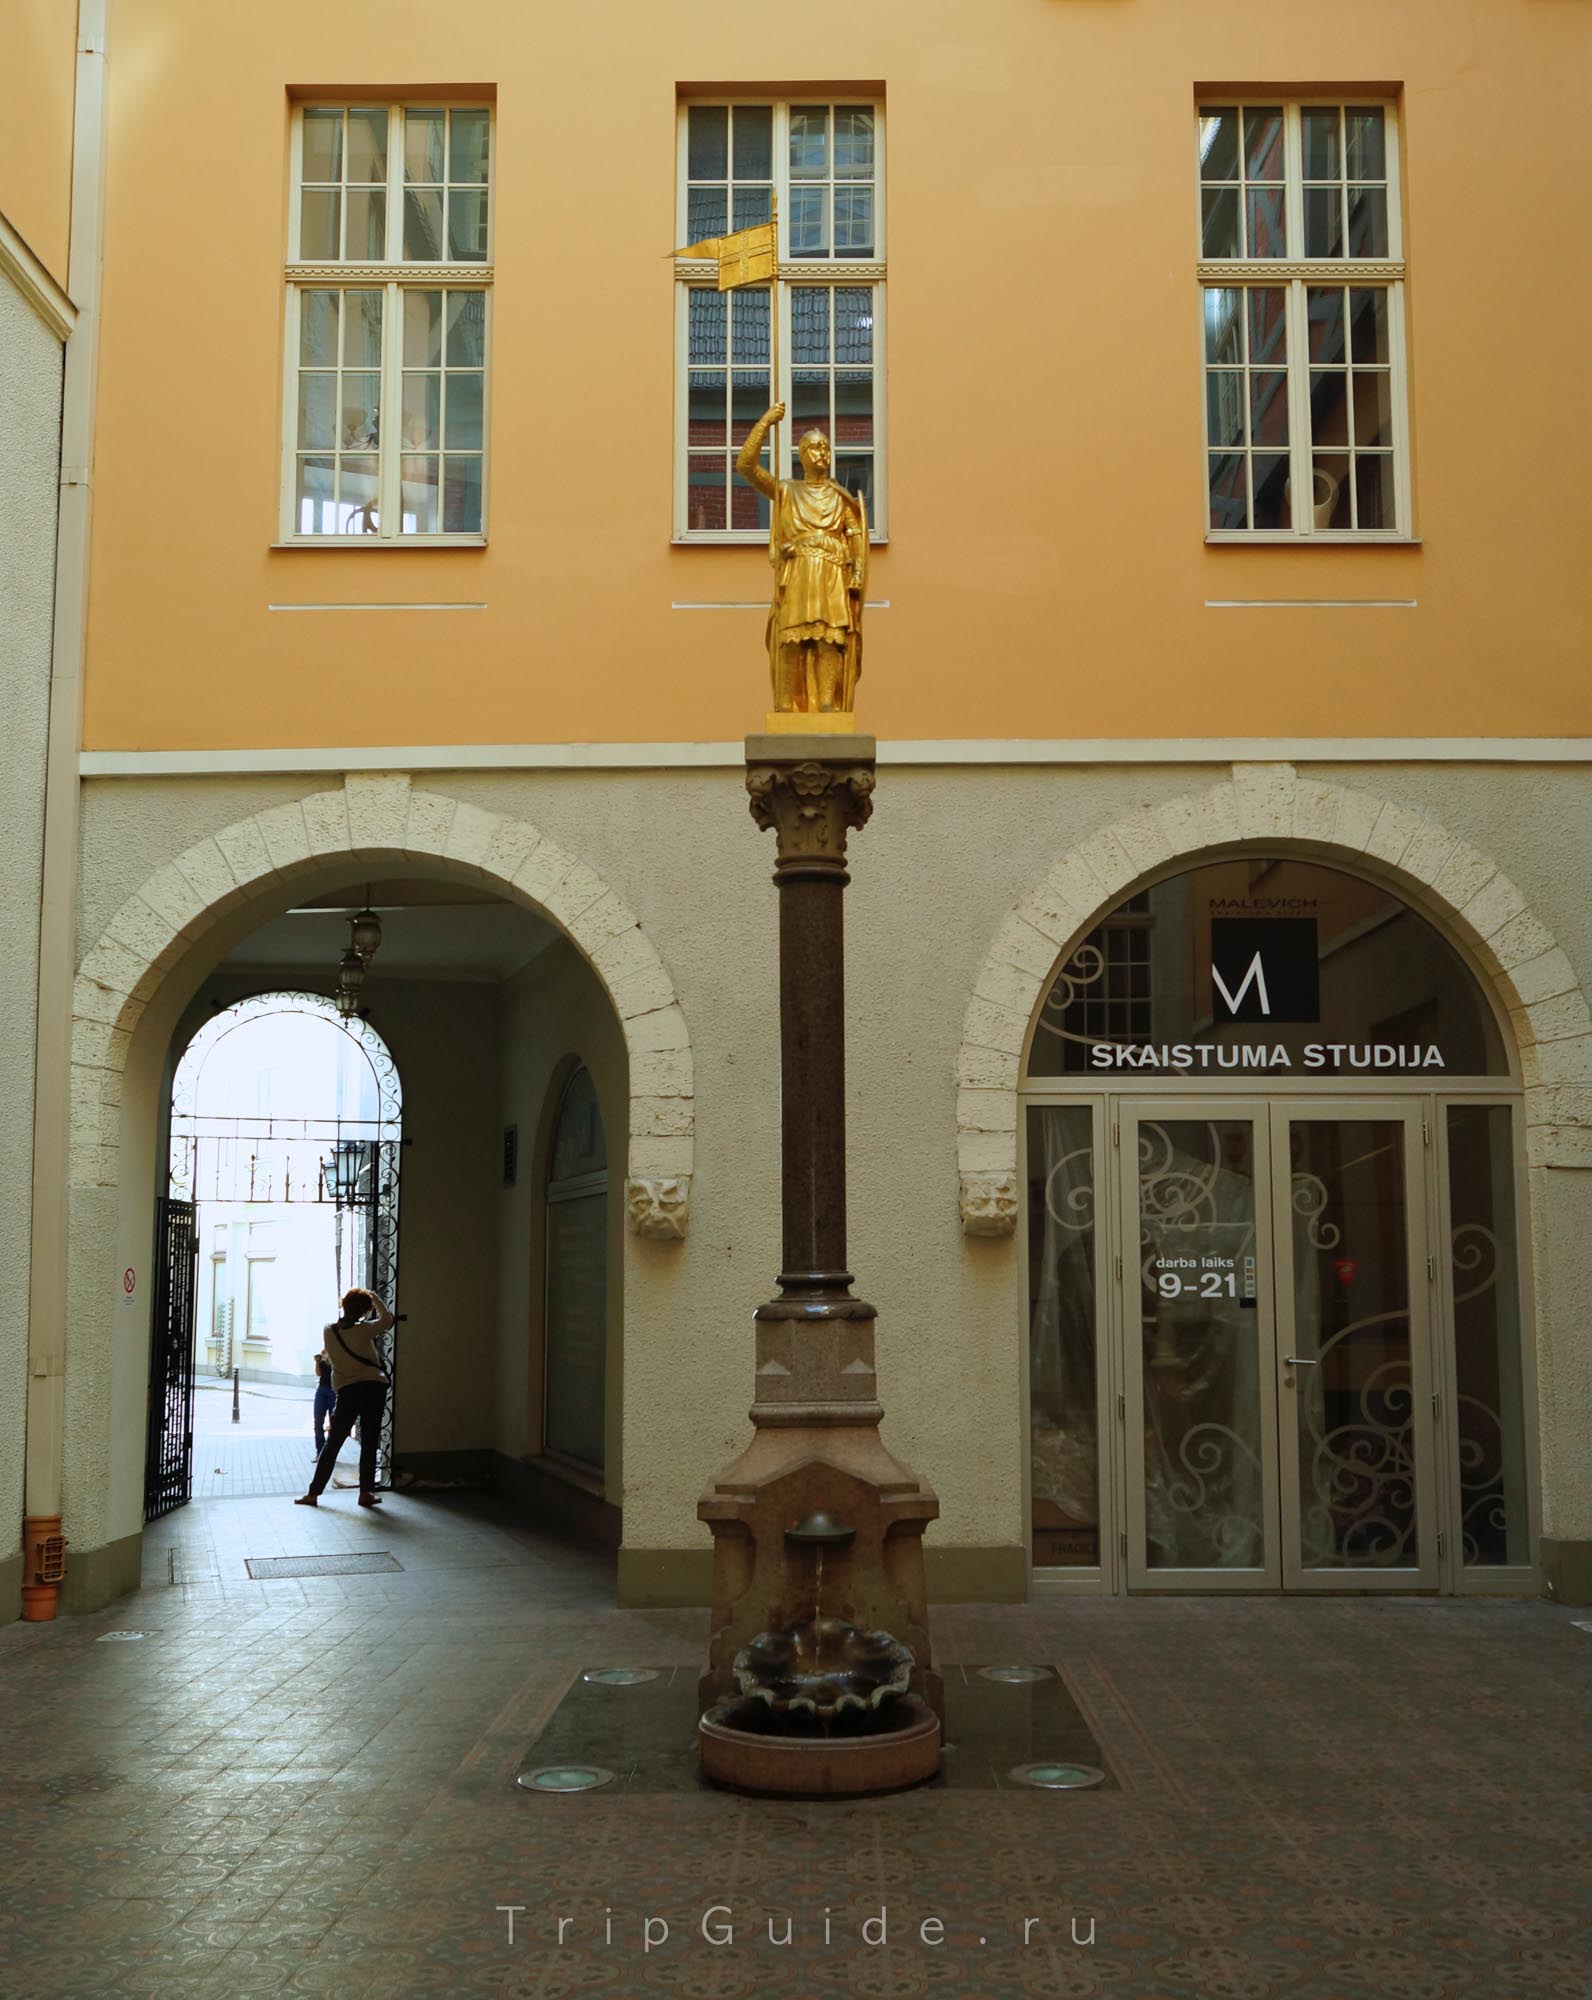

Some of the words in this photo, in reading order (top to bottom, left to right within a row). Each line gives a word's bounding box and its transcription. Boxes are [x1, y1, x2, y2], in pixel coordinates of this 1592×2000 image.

[1209, 898, 1318, 909] MALEVICH
[1091, 1044, 1292, 1068] SKAISTUMA
[1303, 1044, 1446, 1068] STUDIJA
[1156, 1257, 1198, 1269] darba
[1201, 1256, 1235, 1268] laiks
[1158, 1272, 1236, 1299] 9-21
